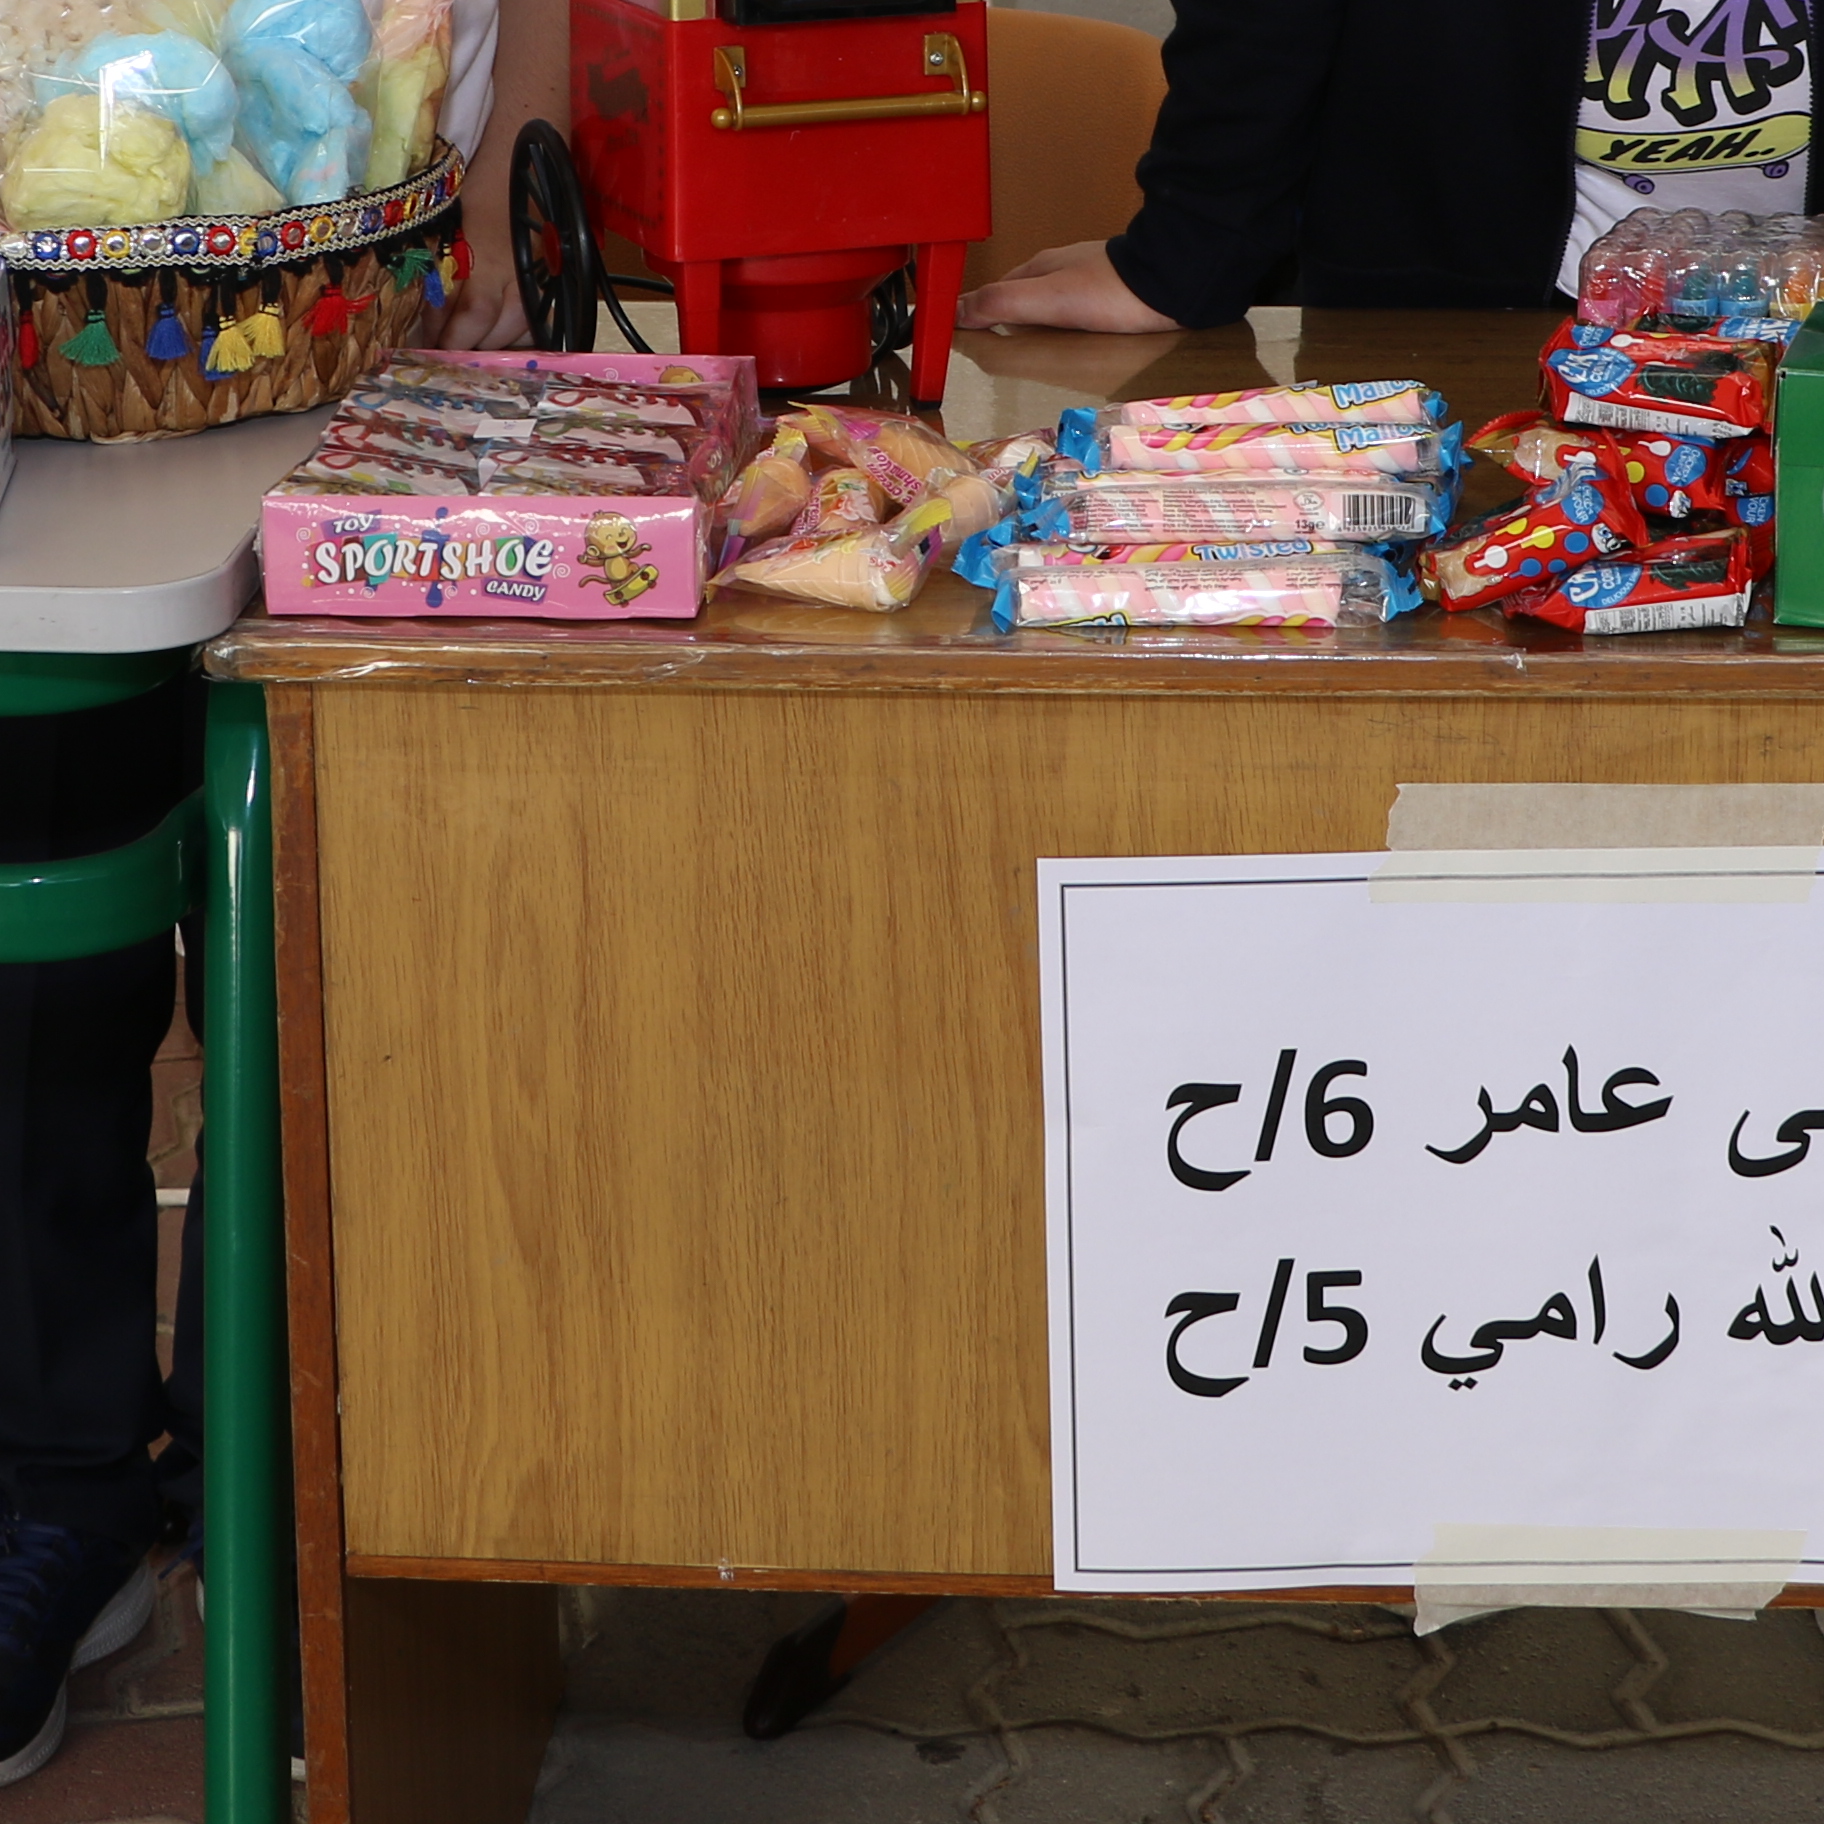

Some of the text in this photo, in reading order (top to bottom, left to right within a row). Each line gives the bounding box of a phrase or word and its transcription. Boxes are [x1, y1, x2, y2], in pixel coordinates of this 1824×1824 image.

[332, 514, 374, 534] TOY
[485, 579, 546, 602] CANDY
[1424, 1045, 1673, 1165] عامر
[1420, 1255, 1681, 1394] رامي
